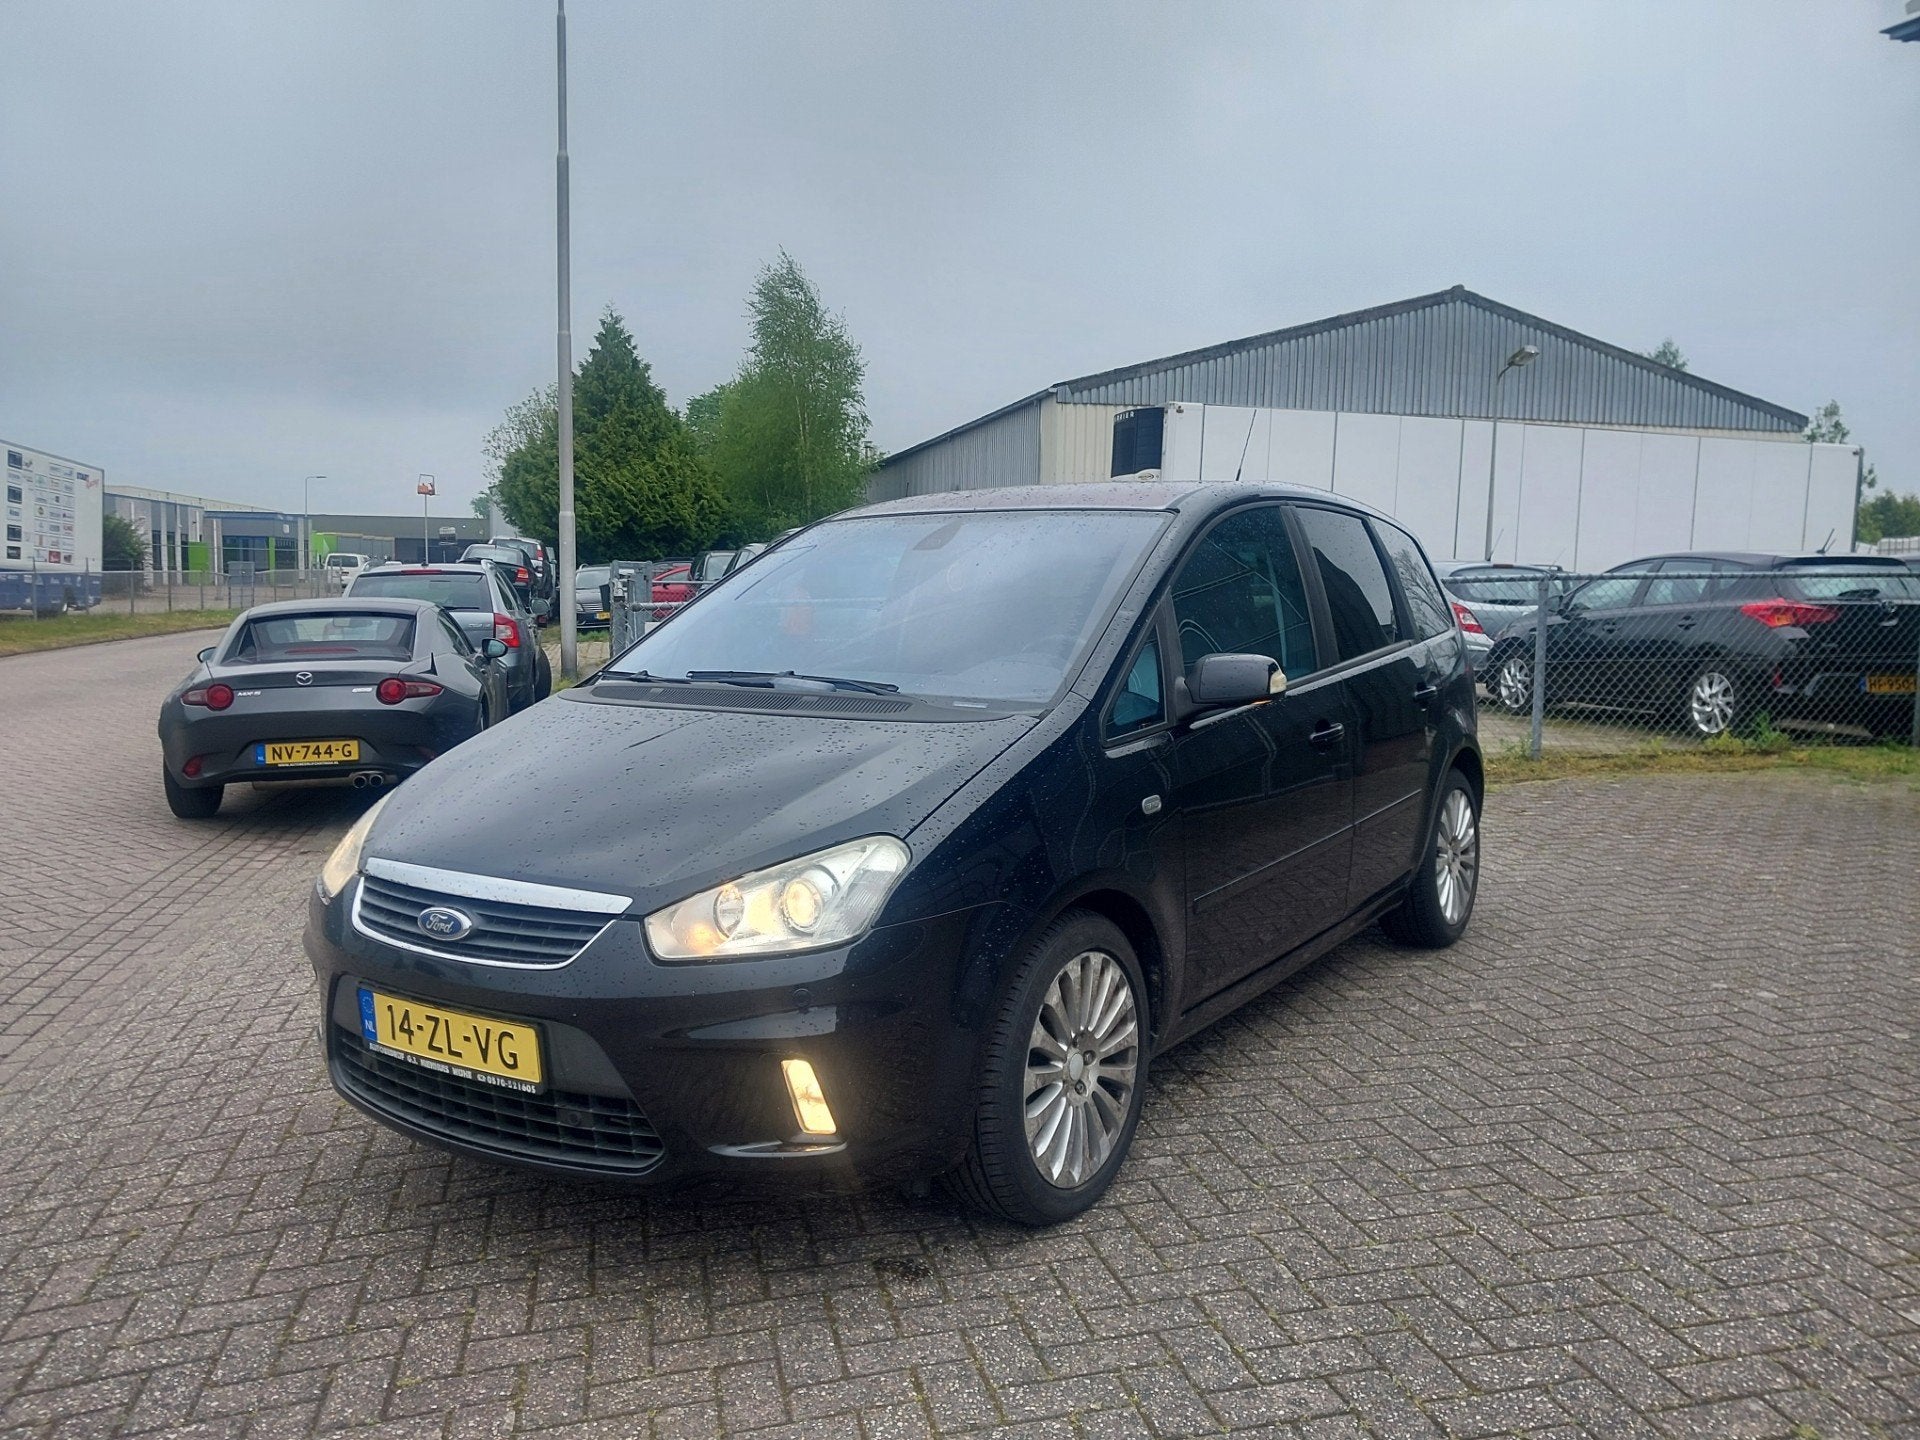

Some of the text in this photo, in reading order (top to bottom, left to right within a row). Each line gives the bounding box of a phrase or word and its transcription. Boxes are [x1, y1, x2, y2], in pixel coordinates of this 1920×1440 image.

[271, 743, 353, 762] NV-744-G
[425, 913, 455, 934] Ford
[364, 1019, 376, 1033] NL
[386, 1004, 519, 1071] 14-ZL-VG
